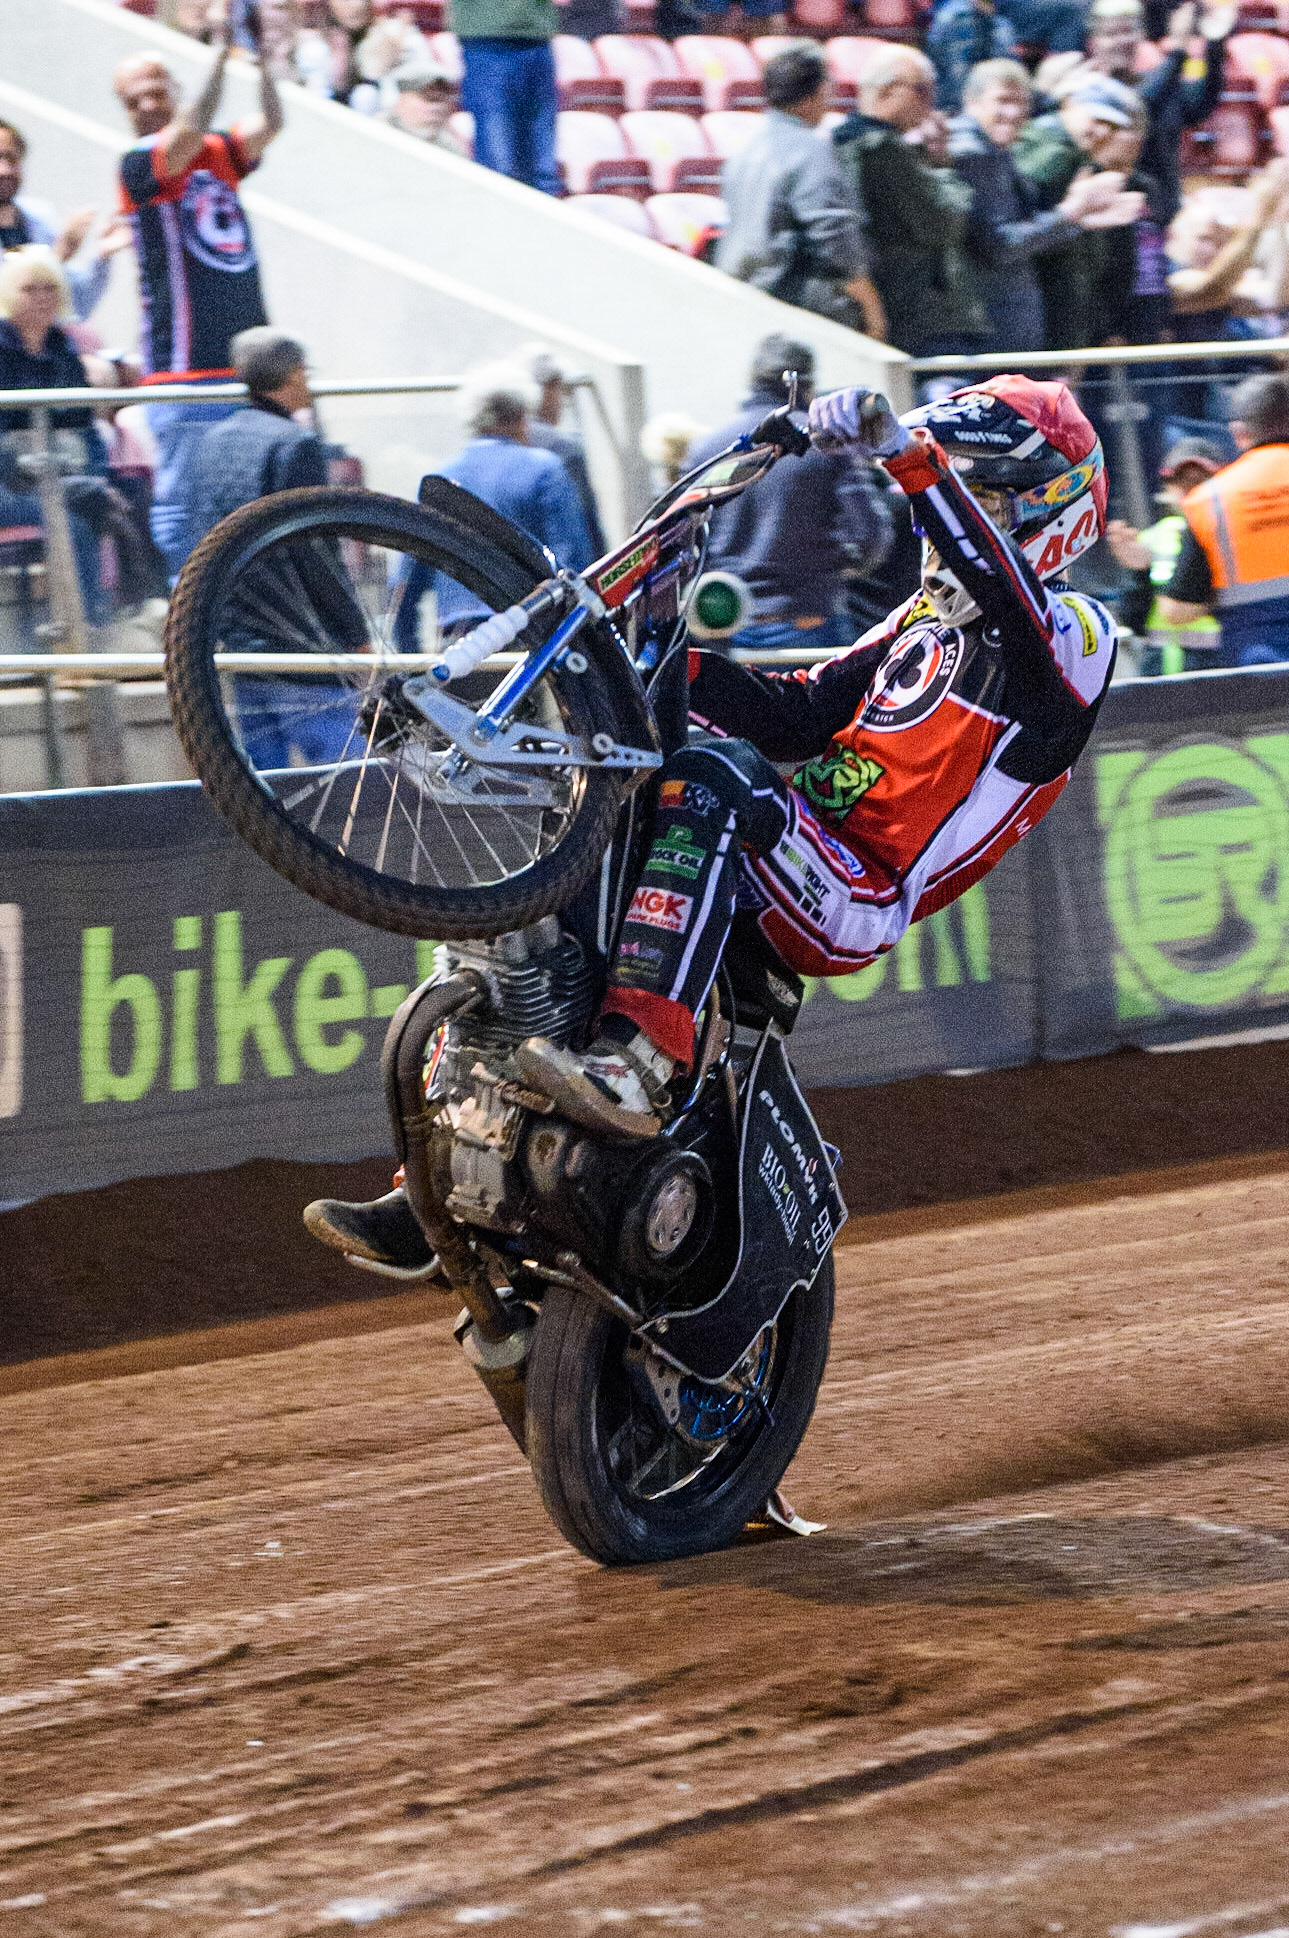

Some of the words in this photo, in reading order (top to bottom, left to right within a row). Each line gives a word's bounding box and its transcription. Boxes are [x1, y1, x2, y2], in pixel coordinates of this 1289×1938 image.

[939, 642, 957, 677] ACES
[628, 889, 686, 920] NGK
[811, 1205, 834, 1255] 99
